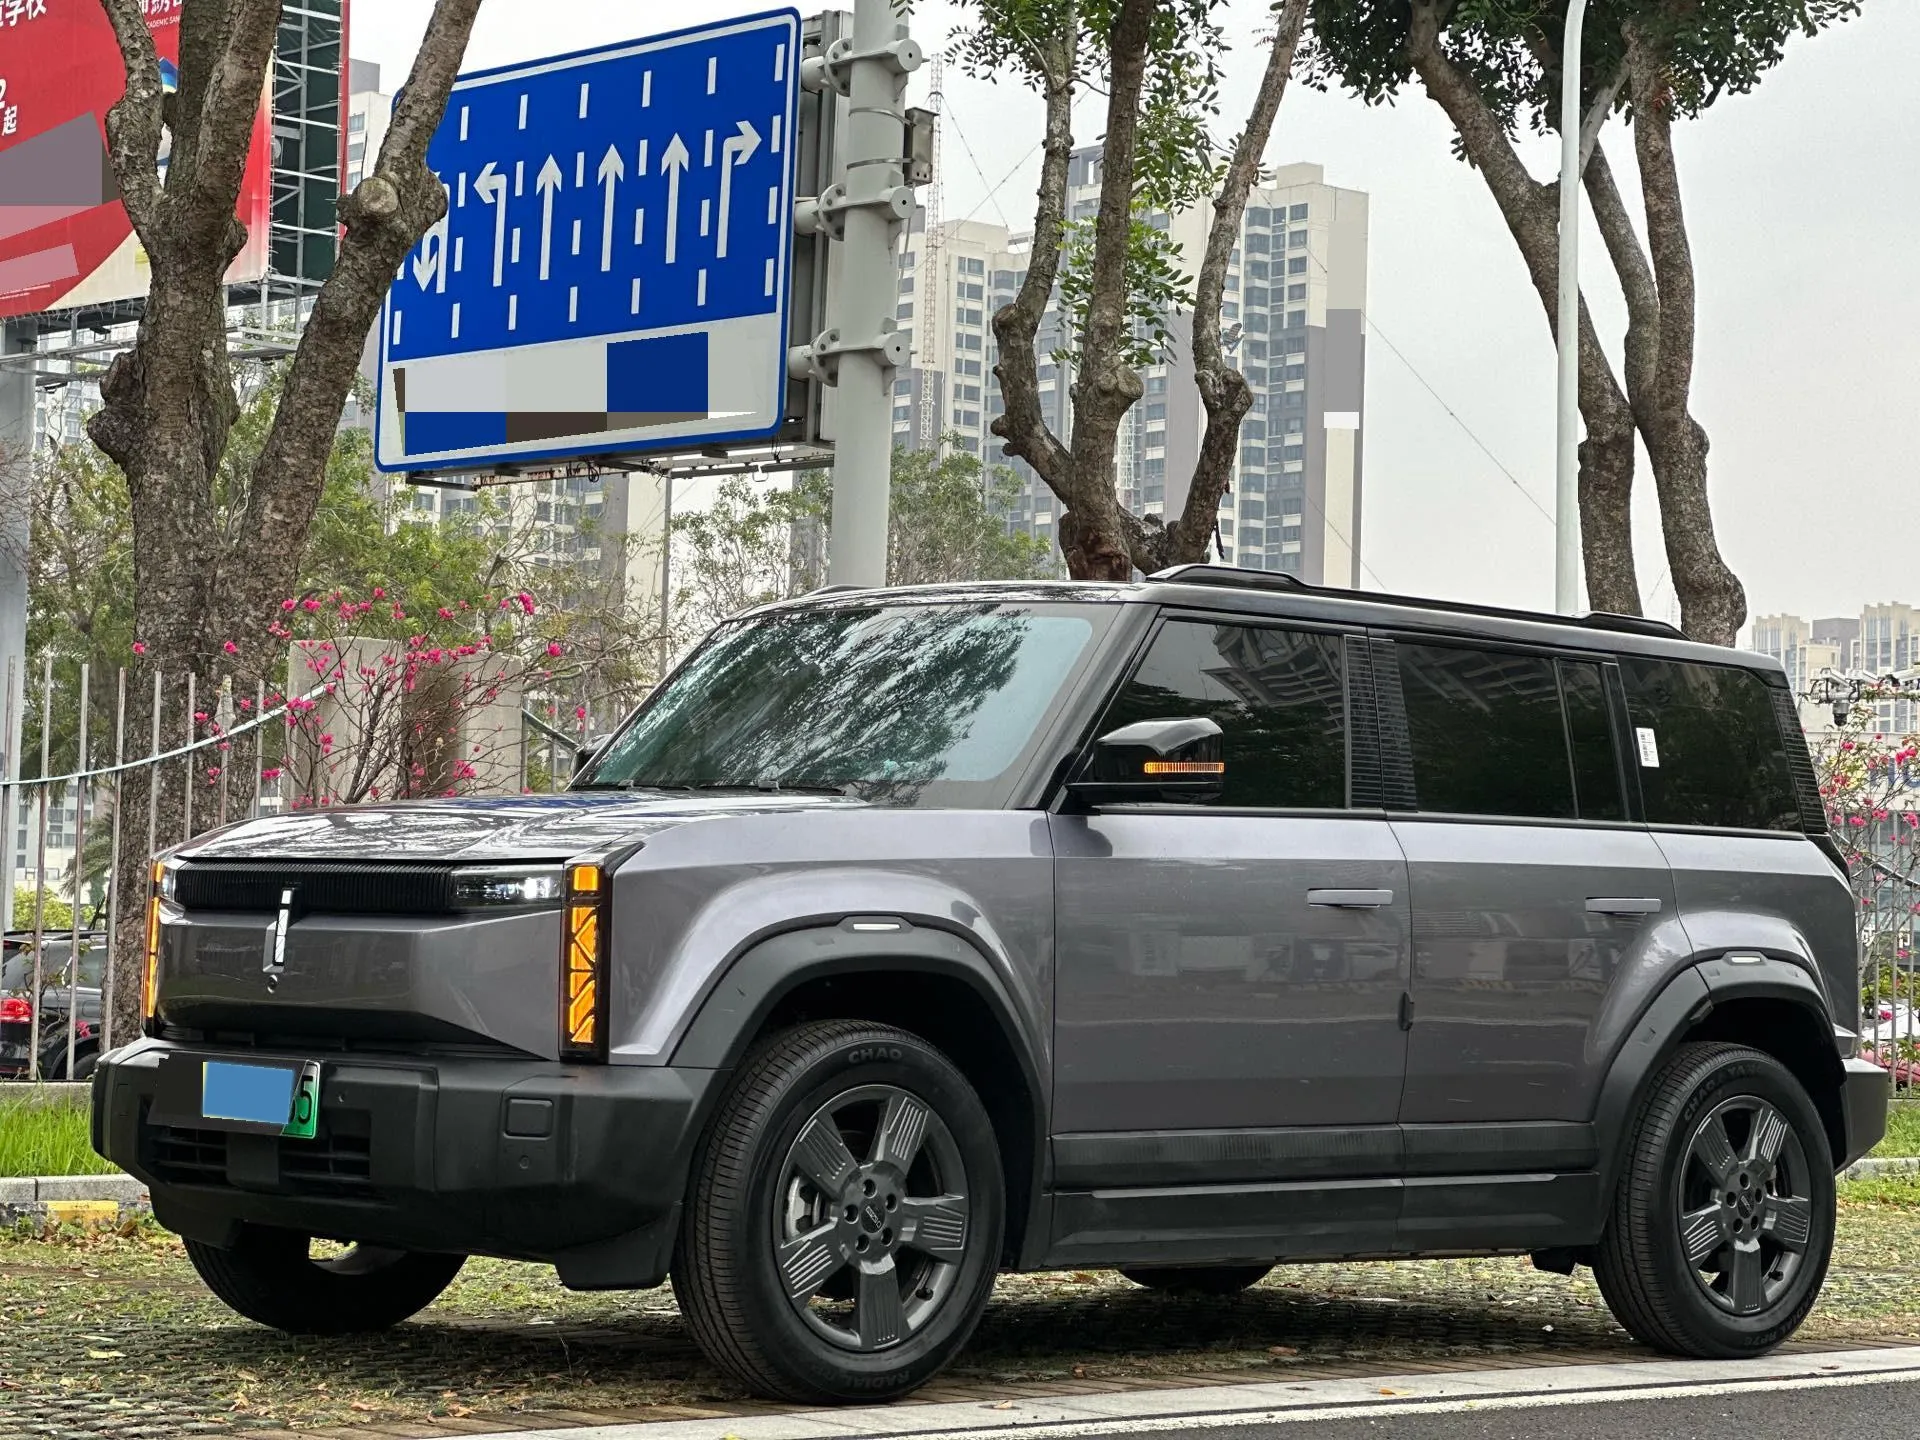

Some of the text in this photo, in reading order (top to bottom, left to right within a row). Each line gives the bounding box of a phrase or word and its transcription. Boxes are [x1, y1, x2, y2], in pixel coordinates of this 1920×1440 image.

[848, 1047, 902, 1064] CHAO
[1684, 1079, 1716, 1121] CHAO
[839, 1370, 910, 1388] RADIAL
